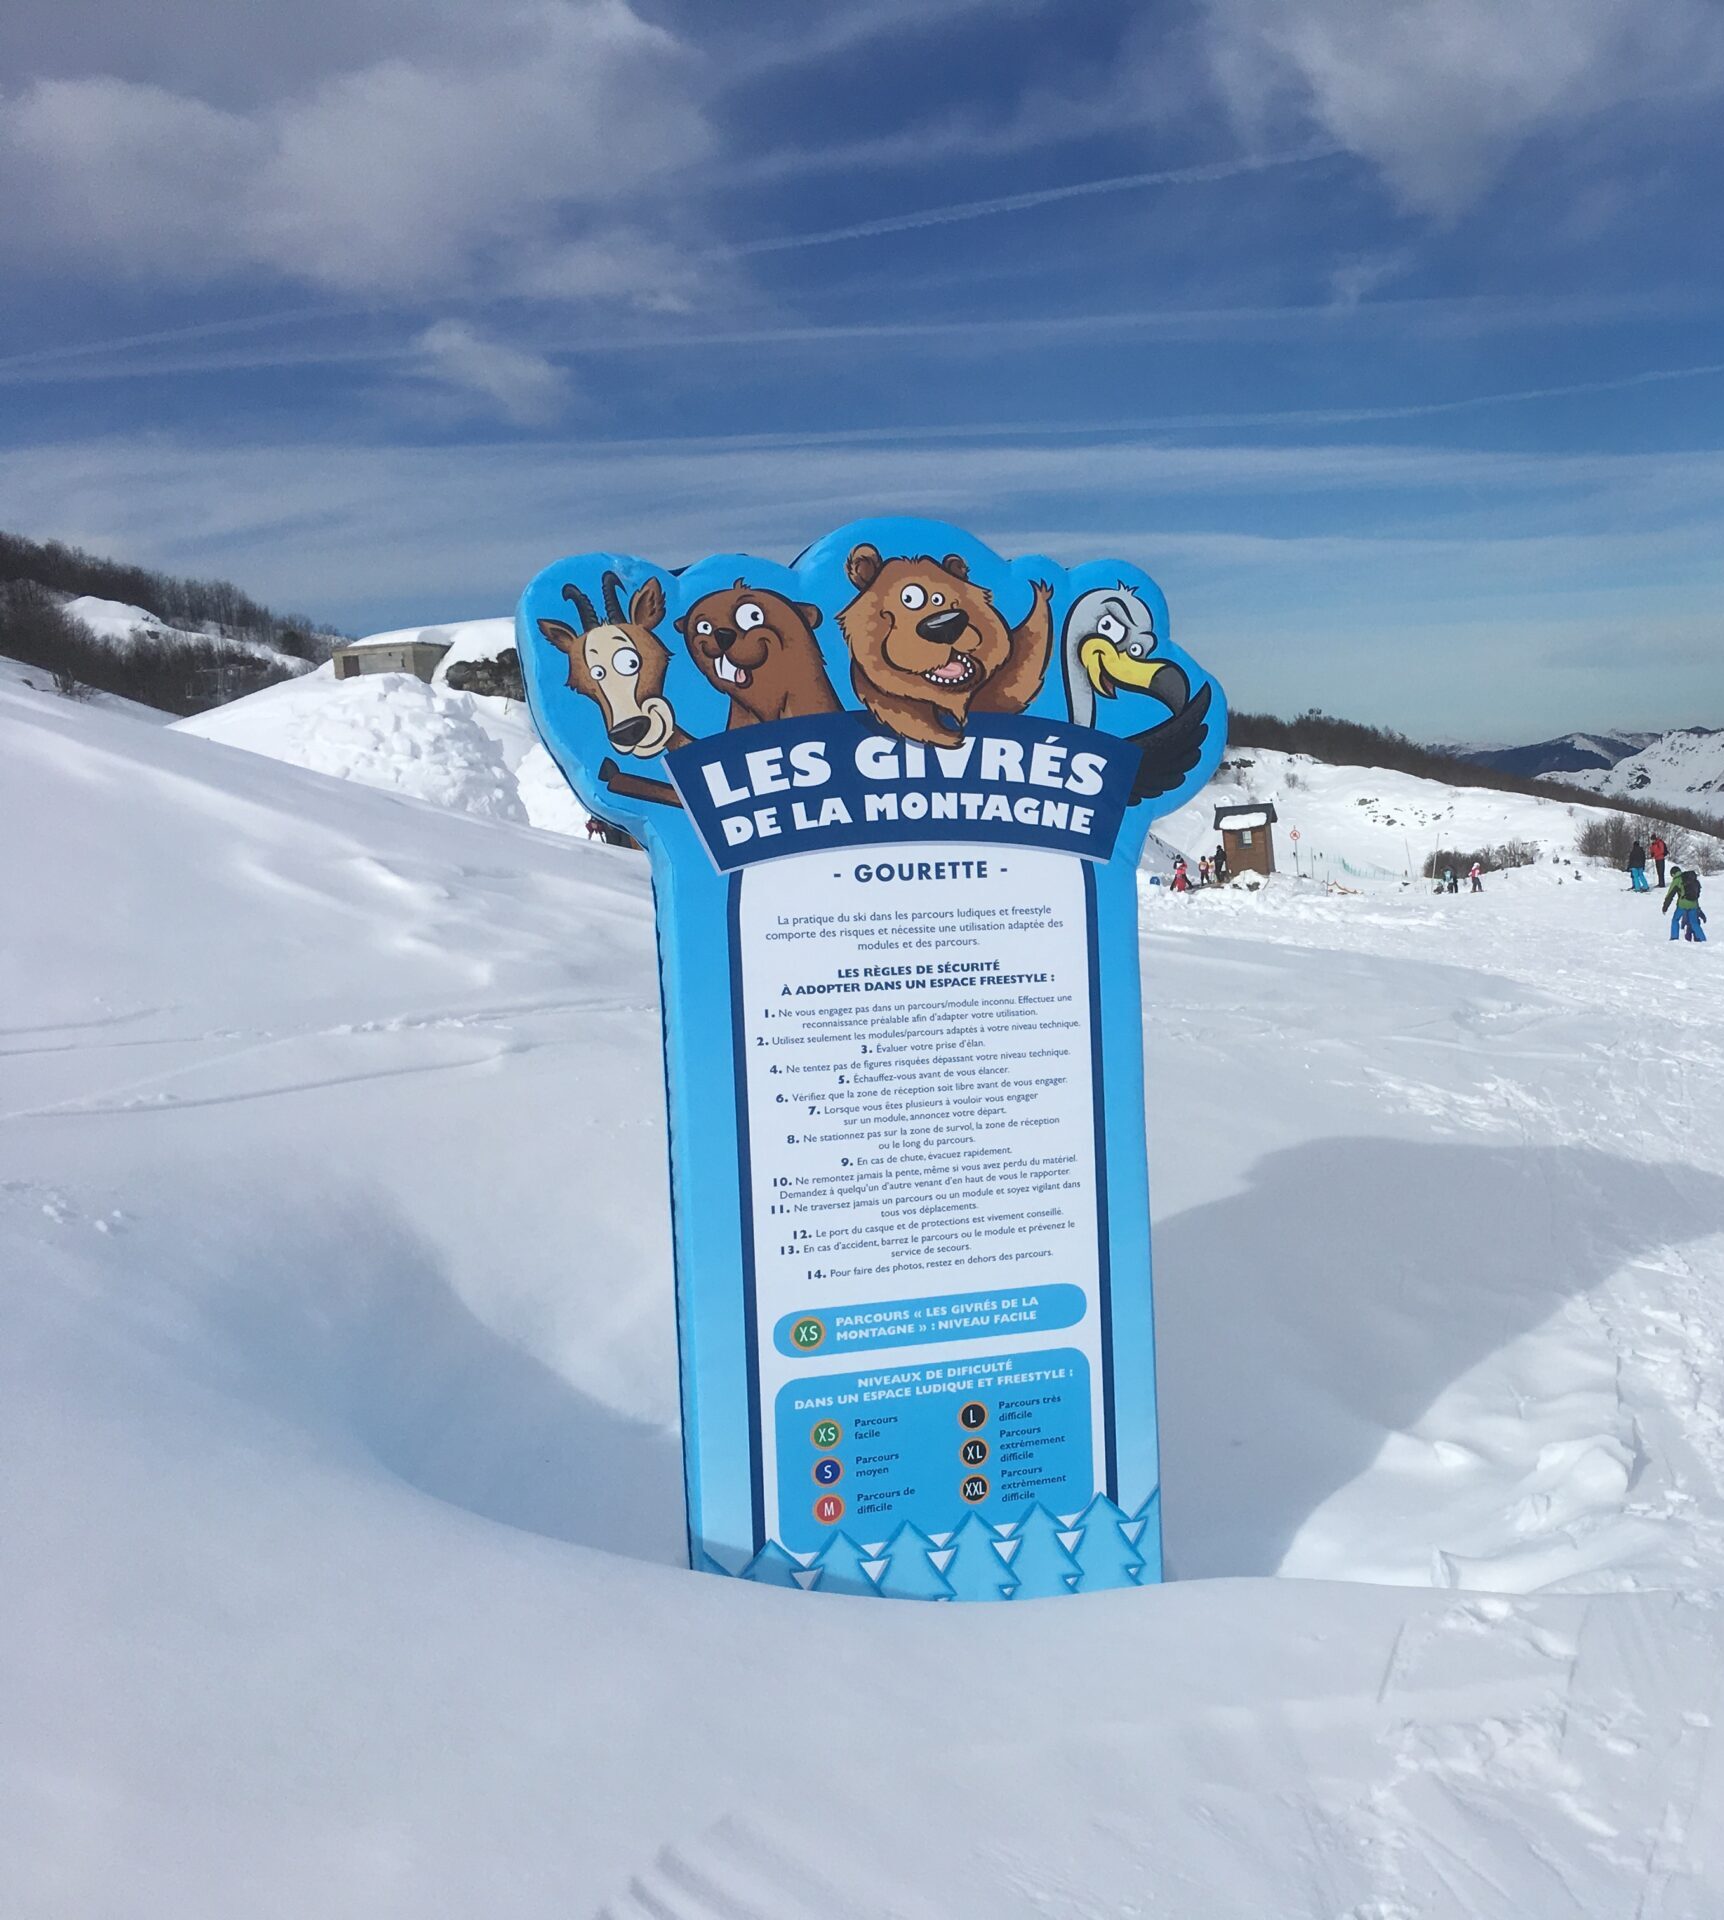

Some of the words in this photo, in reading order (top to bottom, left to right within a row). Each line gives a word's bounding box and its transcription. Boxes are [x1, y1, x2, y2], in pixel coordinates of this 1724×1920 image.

[701, 740, 832, 808] LES
[854, 735, 1108, 796] GIVRÉS
[720, 806, 782, 847] DE
[791, 796, 853, 831] LA
[864, 791, 1095, 836] MONTAGNE
[854, 860, 988, 883] GOURETTE
[777, 914, 789, 924] La
[792, 913, 834, 926] pratique
[837, 911, 850, 922] du
[852, 911, 866, 922] ski
[869, 910, 892, 921] dans
[894, 909, 908, 920] les
[911, 910, 954, 922] parcours
[956, 907, 996, 920] ludiques
[998, 907, 1009, 916] et
[1011, 904, 1051, 917] freestyle
[765, 929, 816, 941] comporte
[818, 927, 836, 938] des
[839, 926, 875, 939] risques
[877, 926, 888, 935] et
[890, 923, 936, 935] nécessite
[938, 924, 956, 933] une
[959, 920, 1005, 932] utilisation
[1007, 919, 1044, 932] adaptée
[1047, 917, 1063, 928] des
[857, 938, 899, 950] modules
[902, 939, 913, 948] et
[915, 937, 932, 948] des
[934, 938, 980, 949] parcours.
[837, 968, 859, 979] LES
[863, 964, 912, 977] RÈGLES
[915, 964, 933, 975] DE
[937, 958, 1000, 973] SÉCURITÉ
[780, 983, 792, 995] À
[795, 982, 861, 995] ADOPTER
[864, 980, 902, 992] DANS
[905, 979, 926, 990] UN
[929, 977, 976, 988] ESPACE
[979, 973, 1047, 986] FREESTYLE
[764, 1008, 775, 1019] 1.
[818, 1005, 853, 1017] engagez
[871, 1001, 891, 1012] dans
[1017, 994, 1054, 1005] Effectuez
[802, 1016, 868, 1028] reconnaissance
[911, 1012, 927, 1023] afin
[970, 1010, 993, 1020] votre
[756, 1036, 769, 1046] 2.
[771, 1033, 805, 1044] Utilisez
[806, 1031, 852, 1043] seulement
[986, 1023, 1009, 1033] votre
[1011, 1021, 1037, 1031] niveau
[860, 1044, 873, 1054] 3.
[910, 1041, 933, 1051] votre
[935, 1039, 956, 1052] prise
[769, 1064, 783, 1074] 4.
[802, 1061, 831, 1071] tentez
[863, 1057, 892, 1070] figures
[975, 1052, 998, 1062] votre
[1000, 1050, 1026, 1060] niveau
[837, 1074, 850, 1084] 5.
[918, 1069, 941, 1079] avant
[955, 1068, 976, 1077] vous
[775, 1093, 788, 1103] 6.
[856, 1088, 878, 1098] zone
[937, 1082, 953, 1093] soit
[955, 1080, 974, 1092] libre
[976, 1080, 999, 1090] avant
[1013, 1079, 1032, 1088] vous
[807, 1105, 821, 1116] 7.
[824, 1103, 860, 1115] Lorsque
[862, 1102, 883, 1111] vous
[905, 1097, 943, 1111] plusieurs
[952, 1094, 982, 1106] vouloir
[984, 1094, 1004, 1104] vous
[1006, 1092, 1038, 1104] engager
[909, 1111, 951, 1122] annoncez
[951, 1109, 975, 1119] votre
[786, 1134, 800, 1144] 8.
[819, 1130, 864, 1141] stationnez
[909, 1126, 930, 1135] zone
[985, 1121, 1005, 1130] zone
[902, 1137, 921, 1150] long
[811, 1172, 855, 1183] remontez
[856, 1168, 883, 1182] jamais
[960, 1163, 980, 1172] vous
[982, 1161, 1001, 1171] avez
[1002, 1157, 1027, 1171] perdu
[840, 1156, 853, 1167] 9.
[779, 1185, 827, 1199] Demandez
[913, 1177, 943, 1188] venant
[964, 1173, 984, 1184] haut
[998, 1172, 1018, 1182] vous
[810, 1199, 851, 1210] traversez
[852, 1195, 879, 1209] jamais
[895, 1193, 933, 1206] parcours
[962, 1186, 993, 1198] module
[1006, 1185, 1030, 1196] soyez
[1031, 1181, 1060, 1194] vigilant
[1062, 1179, 1080, 1190] dans
[880, 1209, 900, 1218] tous
[829, 1225, 849, 1238] port
[864, 1223, 894, 1234] casque
[921, 1215, 969, 1231] protections
[986, 1211, 1024, 1223] vivement
[880, 1235, 909, 1246] barrez
[920, 1231, 958, 1244] parcours
[984, 1224, 1015, 1237] module
[891, 1246, 921, 1258] service
[829, 1267, 851, 1277] Pour
[853, 1264, 872, 1275] faire
[925, 1258, 952, 1269] restez
[967, 1253, 996, 1265] dehors
[835, 1309, 909, 1325] PARCOURS
[925, 1305, 947, 1317] LES
[950, 1299, 997, 1314] GIVRÉS
[1001, 1299, 1017, 1310] DE
[1021, 1297, 1038, 1308] LA
[799, 1324, 819, 1342] XS
[836, 1324, 914, 1341] MONTAGNE
[938, 1316, 989, 1331] NIVEAU
[993, 1312, 1036, 1325] FACILE
[857, 1371, 921, 1386] NIVEAUX
[925, 1369, 943, 1380] DE
[794, 1396, 833, 1410] DANS
[837, 1393, 858, 1405] UN
[863, 1387, 911, 1402] ESPACE
[915, 1380, 973, 1396] LUDIQUE
[977, 1378, 993, 1389] ET
[997, 1370, 1065, 1387] FREESTYLE
[998, 1397, 1040, 1409] Parcours
[1042, 1395, 1062, 1404] très
[854, 1415, 898, 1428] Parcours
[969, 1409, 977, 1424] L
[998, 1410, 1033, 1422] difficile
[818, 1426, 836, 1443] XS
[854, 1429, 881, 1440] facile
[999, 1426, 1041, 1438] Parcours
[855, 1453, 900, 1465] Parcours
[967, 1445, 983, 1461] XL
[1000, 1450, 1034, 1463] difficile
[824, 1465, 832, 1479] S
[855, 1466, 889, 1478] moyen
[1001, 1466, 1043, 1478] Parcours
[856, 1490, 901, 1502] Parcours
[903, 1487, 916, 1496] de
[965, 1481, 985, 1497] XXL
[1001, 1491, 1036, 1503] difficile
[824, 1501, 835, 1517] M
[857, 1502, 893, 1515] difficile
